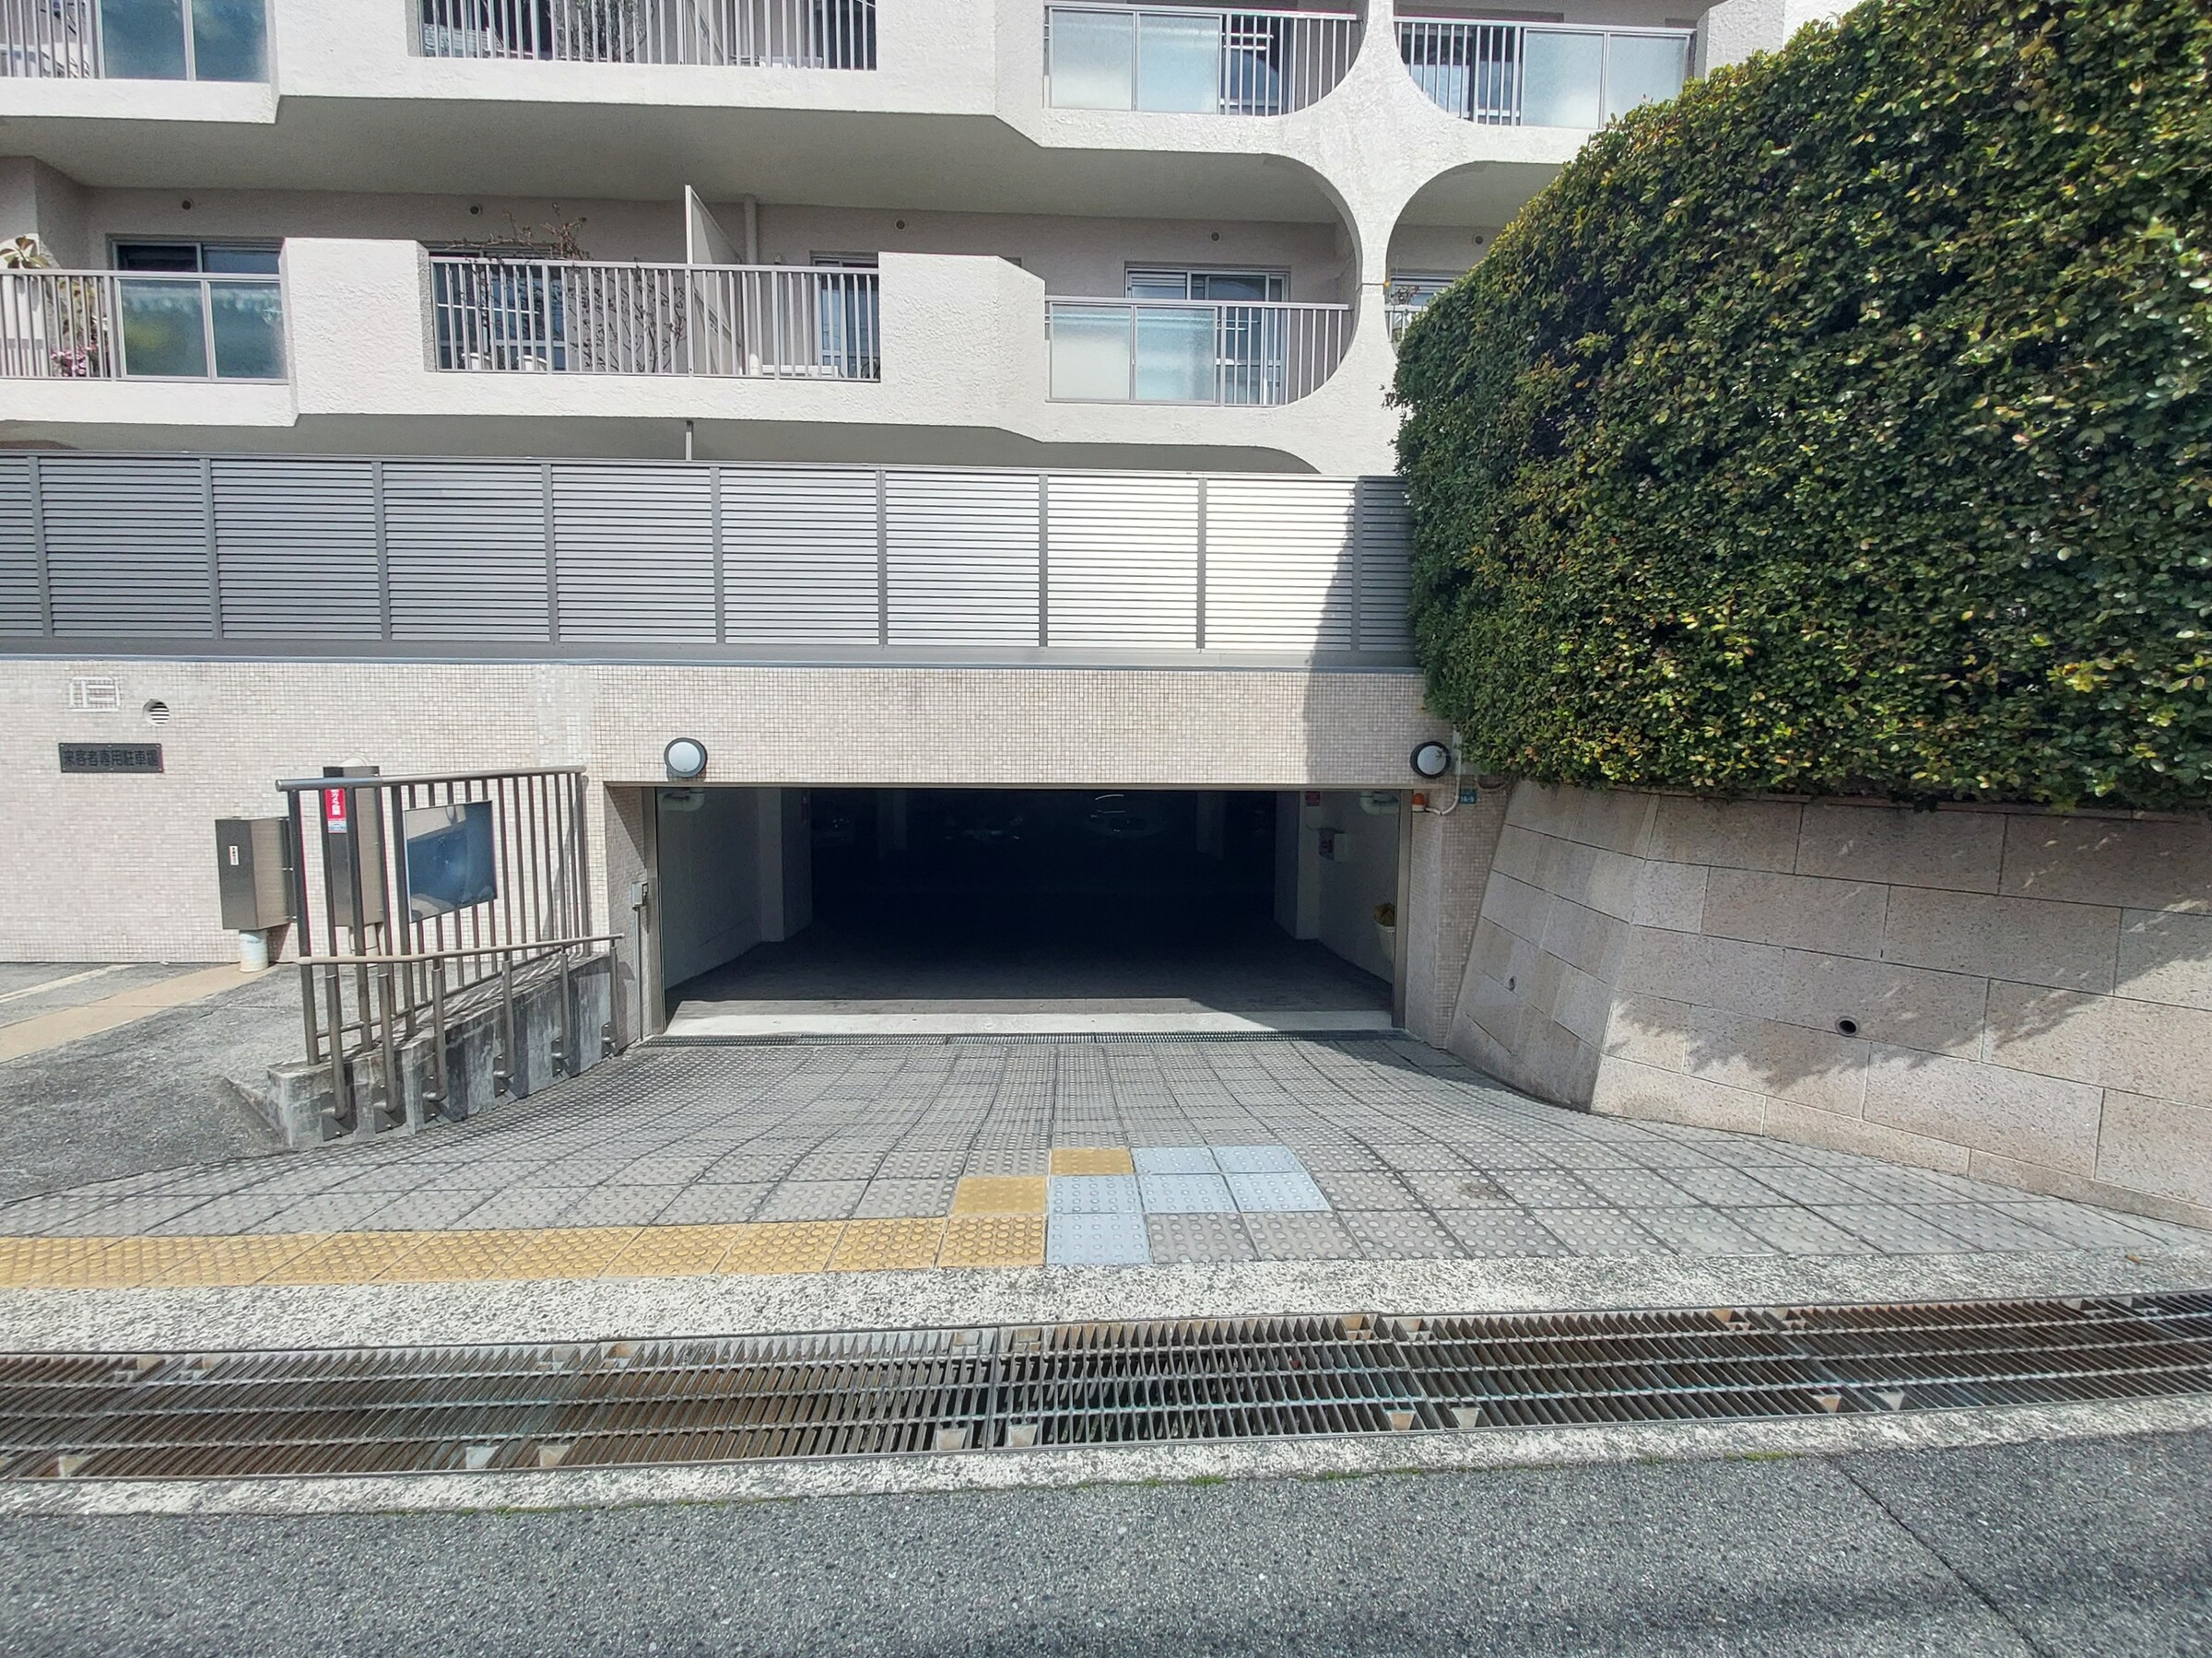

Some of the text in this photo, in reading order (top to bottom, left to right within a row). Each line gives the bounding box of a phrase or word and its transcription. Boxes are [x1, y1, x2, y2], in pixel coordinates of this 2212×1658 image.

[63, 748, 159, 767] 来客者専用駐車場
